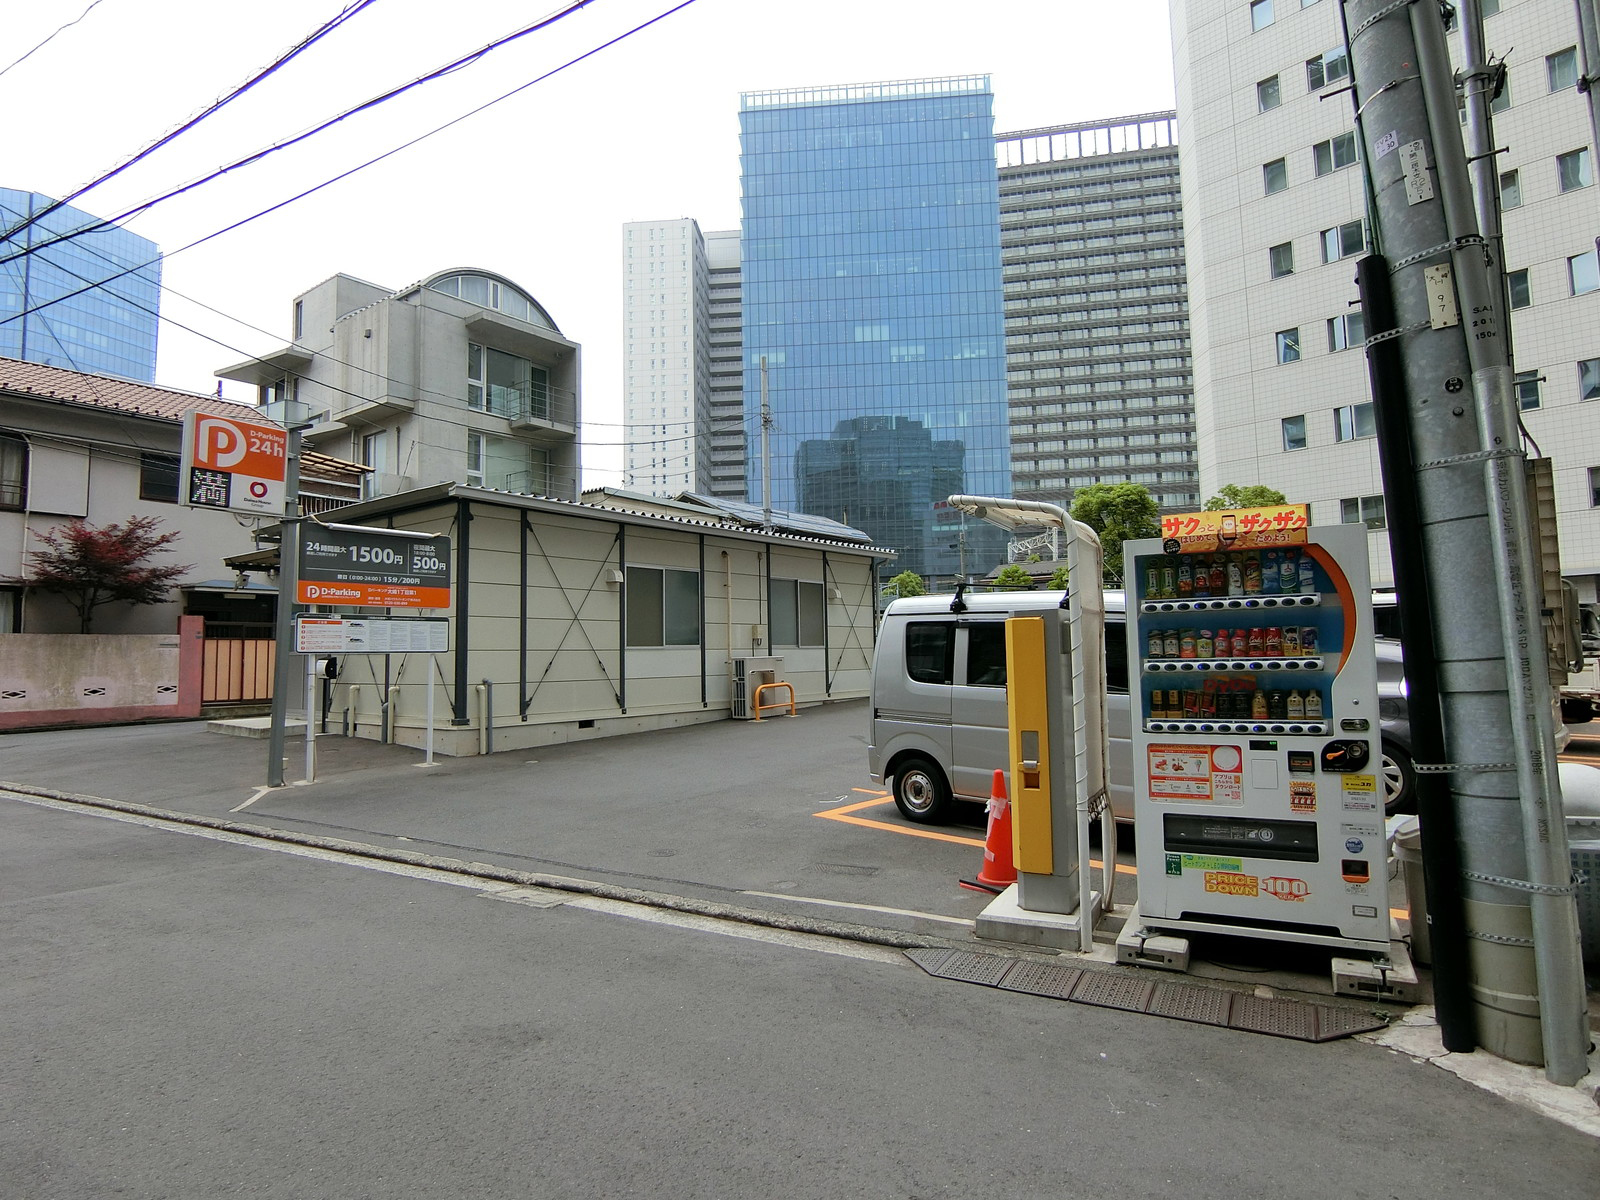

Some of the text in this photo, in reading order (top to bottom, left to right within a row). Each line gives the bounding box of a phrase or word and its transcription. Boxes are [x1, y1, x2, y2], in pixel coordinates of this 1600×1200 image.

[250, 430, 285, 444] D-Parking
[249, 438, 284, 458] 24h
[1239, 510, 1308, 535] ザクザク
[349, 545, 404, 565] 1500円
[412, 556, 446, 571] 500円
[321, 587, 361, 597] D-Parking
[1205, 872, 1258, 885] PRICE
[1205, 883, 1258, 896] DOWN
[1263, 878, 1308, 896] 100
